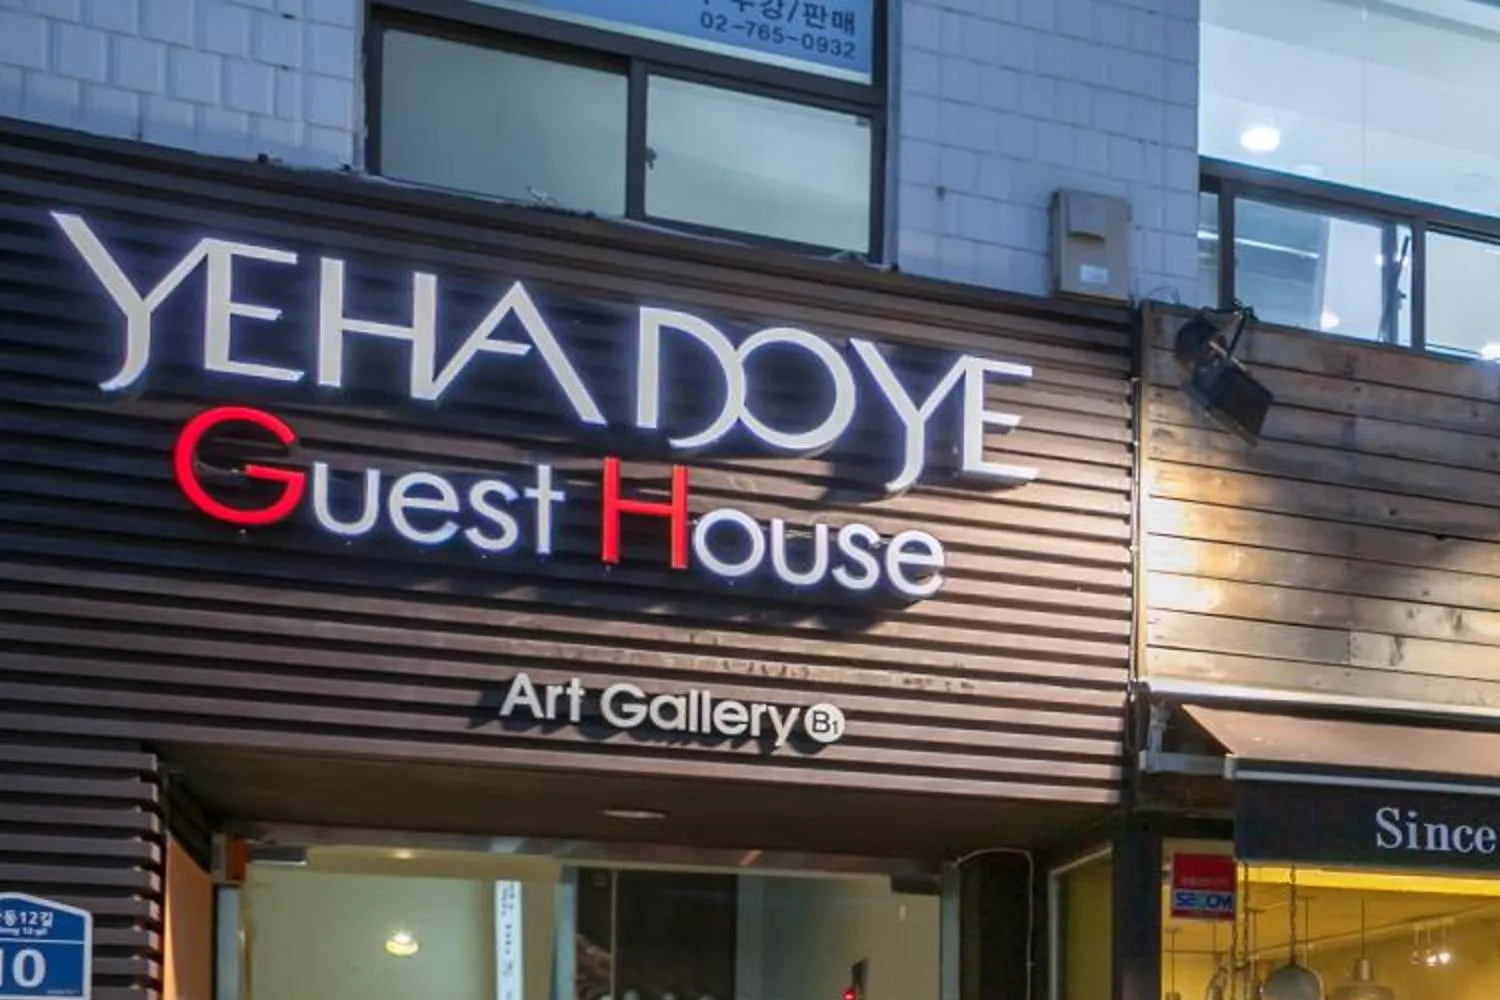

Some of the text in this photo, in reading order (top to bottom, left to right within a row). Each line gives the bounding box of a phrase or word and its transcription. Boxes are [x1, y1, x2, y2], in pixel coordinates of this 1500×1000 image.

[700, 11, 856, 59] 02-765-0932
[50, 210, 1040, 492] YEHA DOYE
[173, 405, 947, 597] Guest House
[499, 672, 587, 723] Art
[601, 683, 801, 746] Gallery
[1374, 805, 1499, 855] Since
[0, 910, 54, 928] 동12길
[1175, 891, 1234, 910] SEOM
